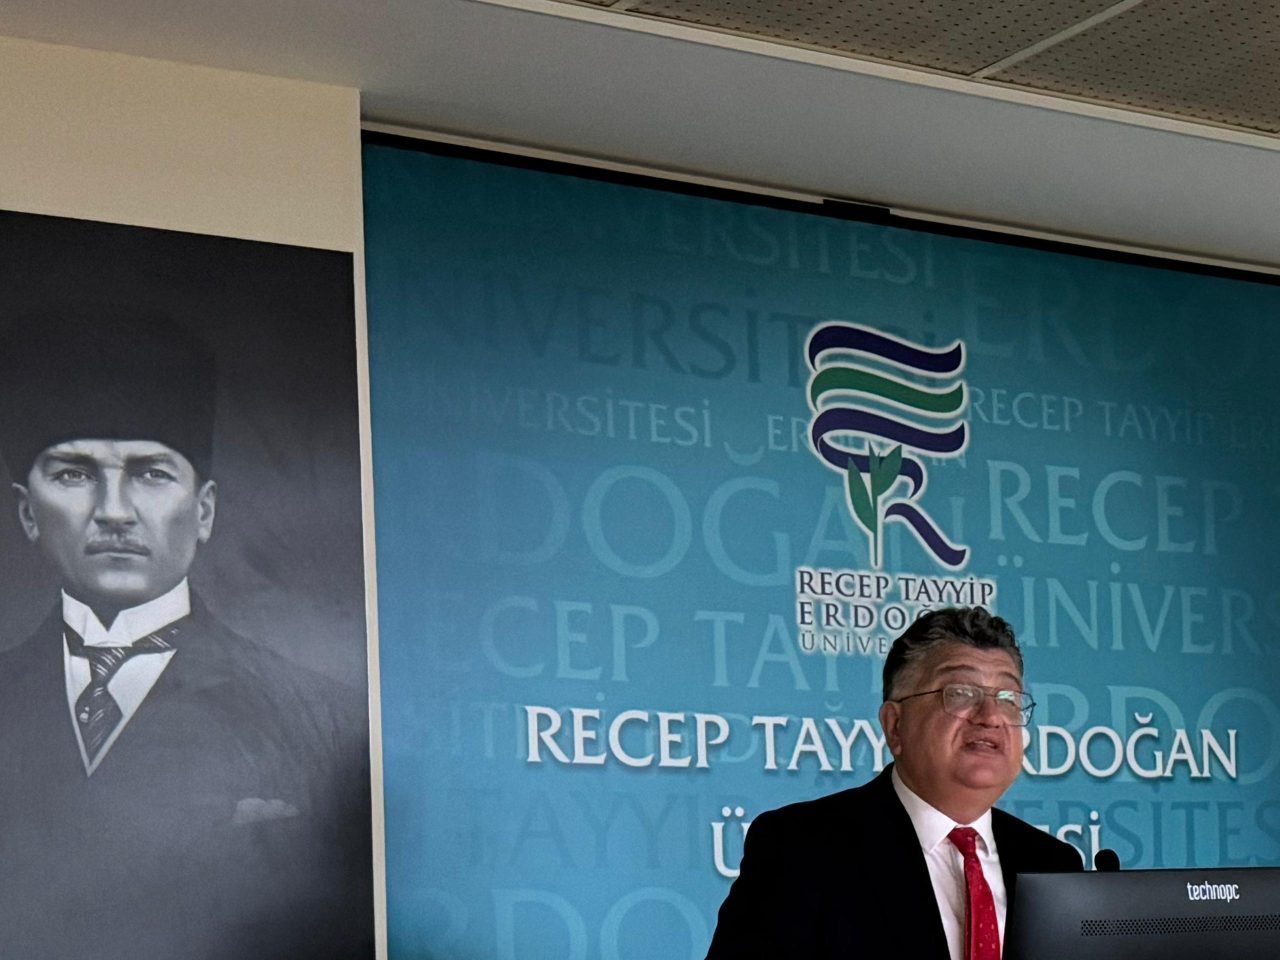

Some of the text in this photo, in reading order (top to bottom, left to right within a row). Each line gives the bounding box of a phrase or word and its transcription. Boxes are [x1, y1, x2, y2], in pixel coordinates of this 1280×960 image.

[798, 570, 994, 606] RECEP TAYYİP
[799, 601, 933, 632] ERDO
[525, 705, 731, 768] RECEP
[752, 715, 888, 772] TAYY
[1021, 712, 1237, 779] RDOĞAN
[1186, 880, 1240, 903] technopc
